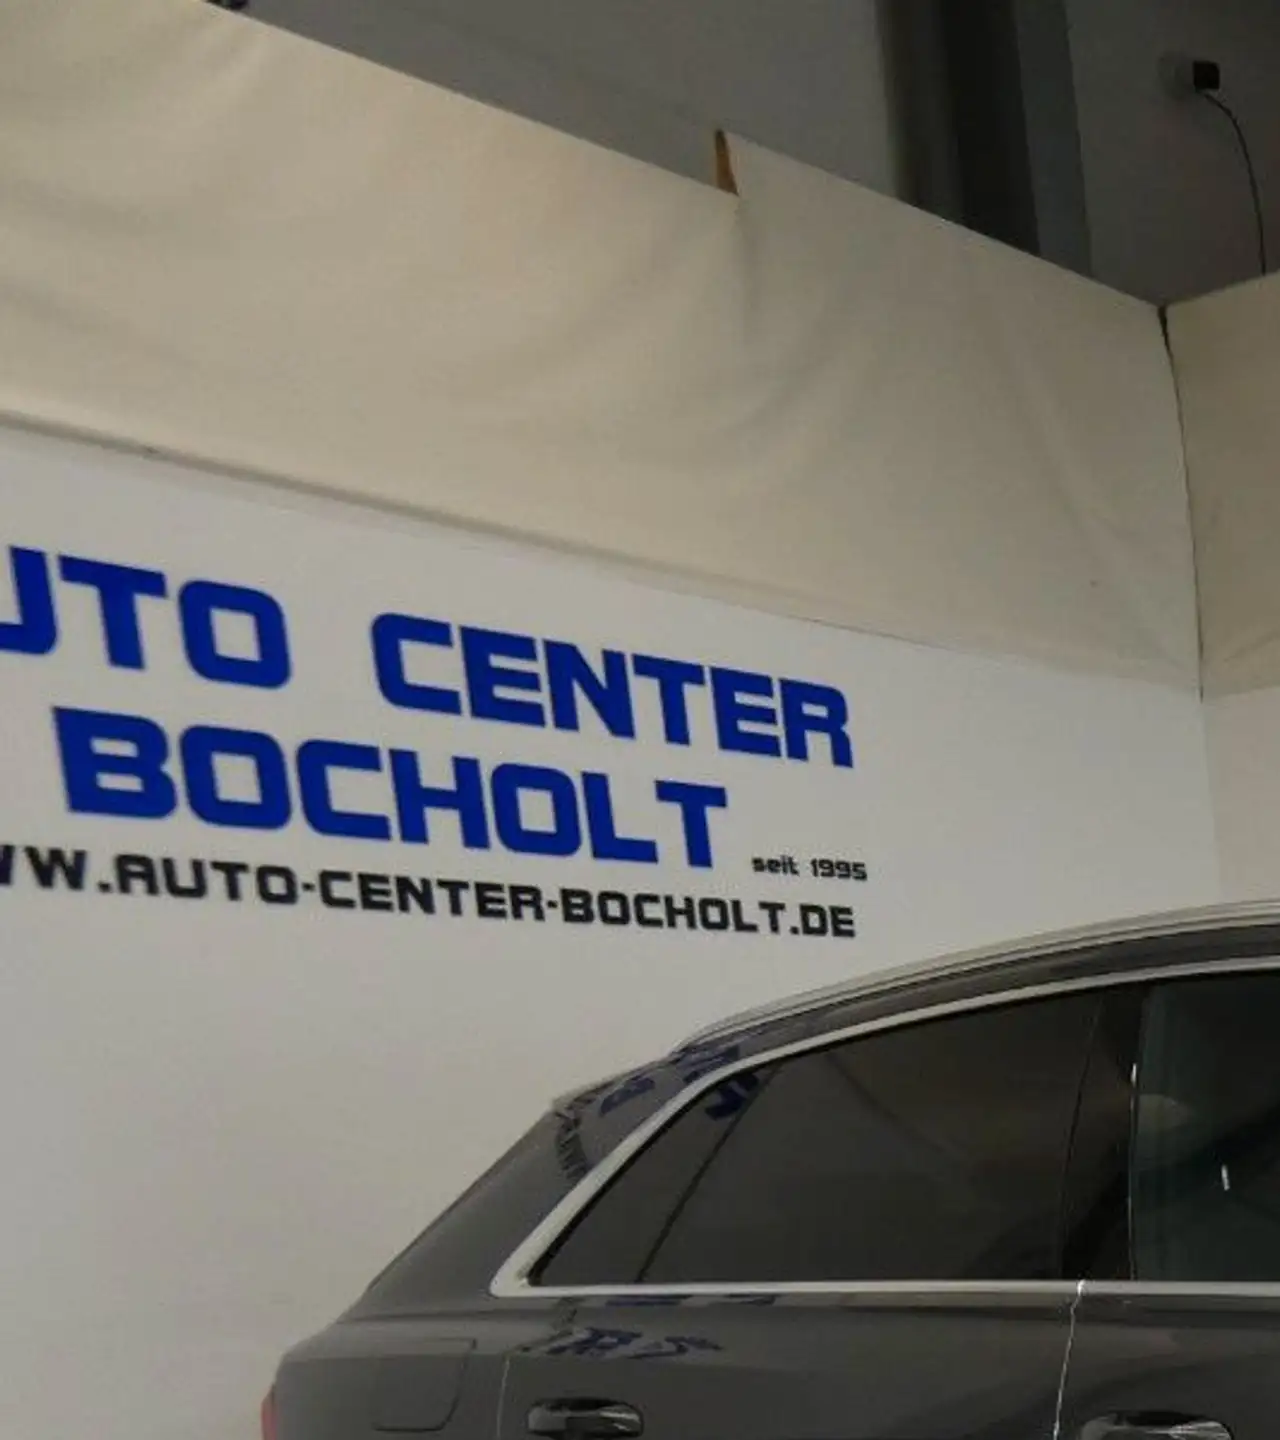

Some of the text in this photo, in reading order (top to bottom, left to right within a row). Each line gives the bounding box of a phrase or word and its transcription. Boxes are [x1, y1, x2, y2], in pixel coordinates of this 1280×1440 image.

[371, 613, 854, 768] CENTER
[55, 708, 727, 868] BOCHOLT
[0, 844, 856, 938] W.AUTO-CENTER-BOCHOLT.DE
[752, 855, 868, 882] seit 1995
